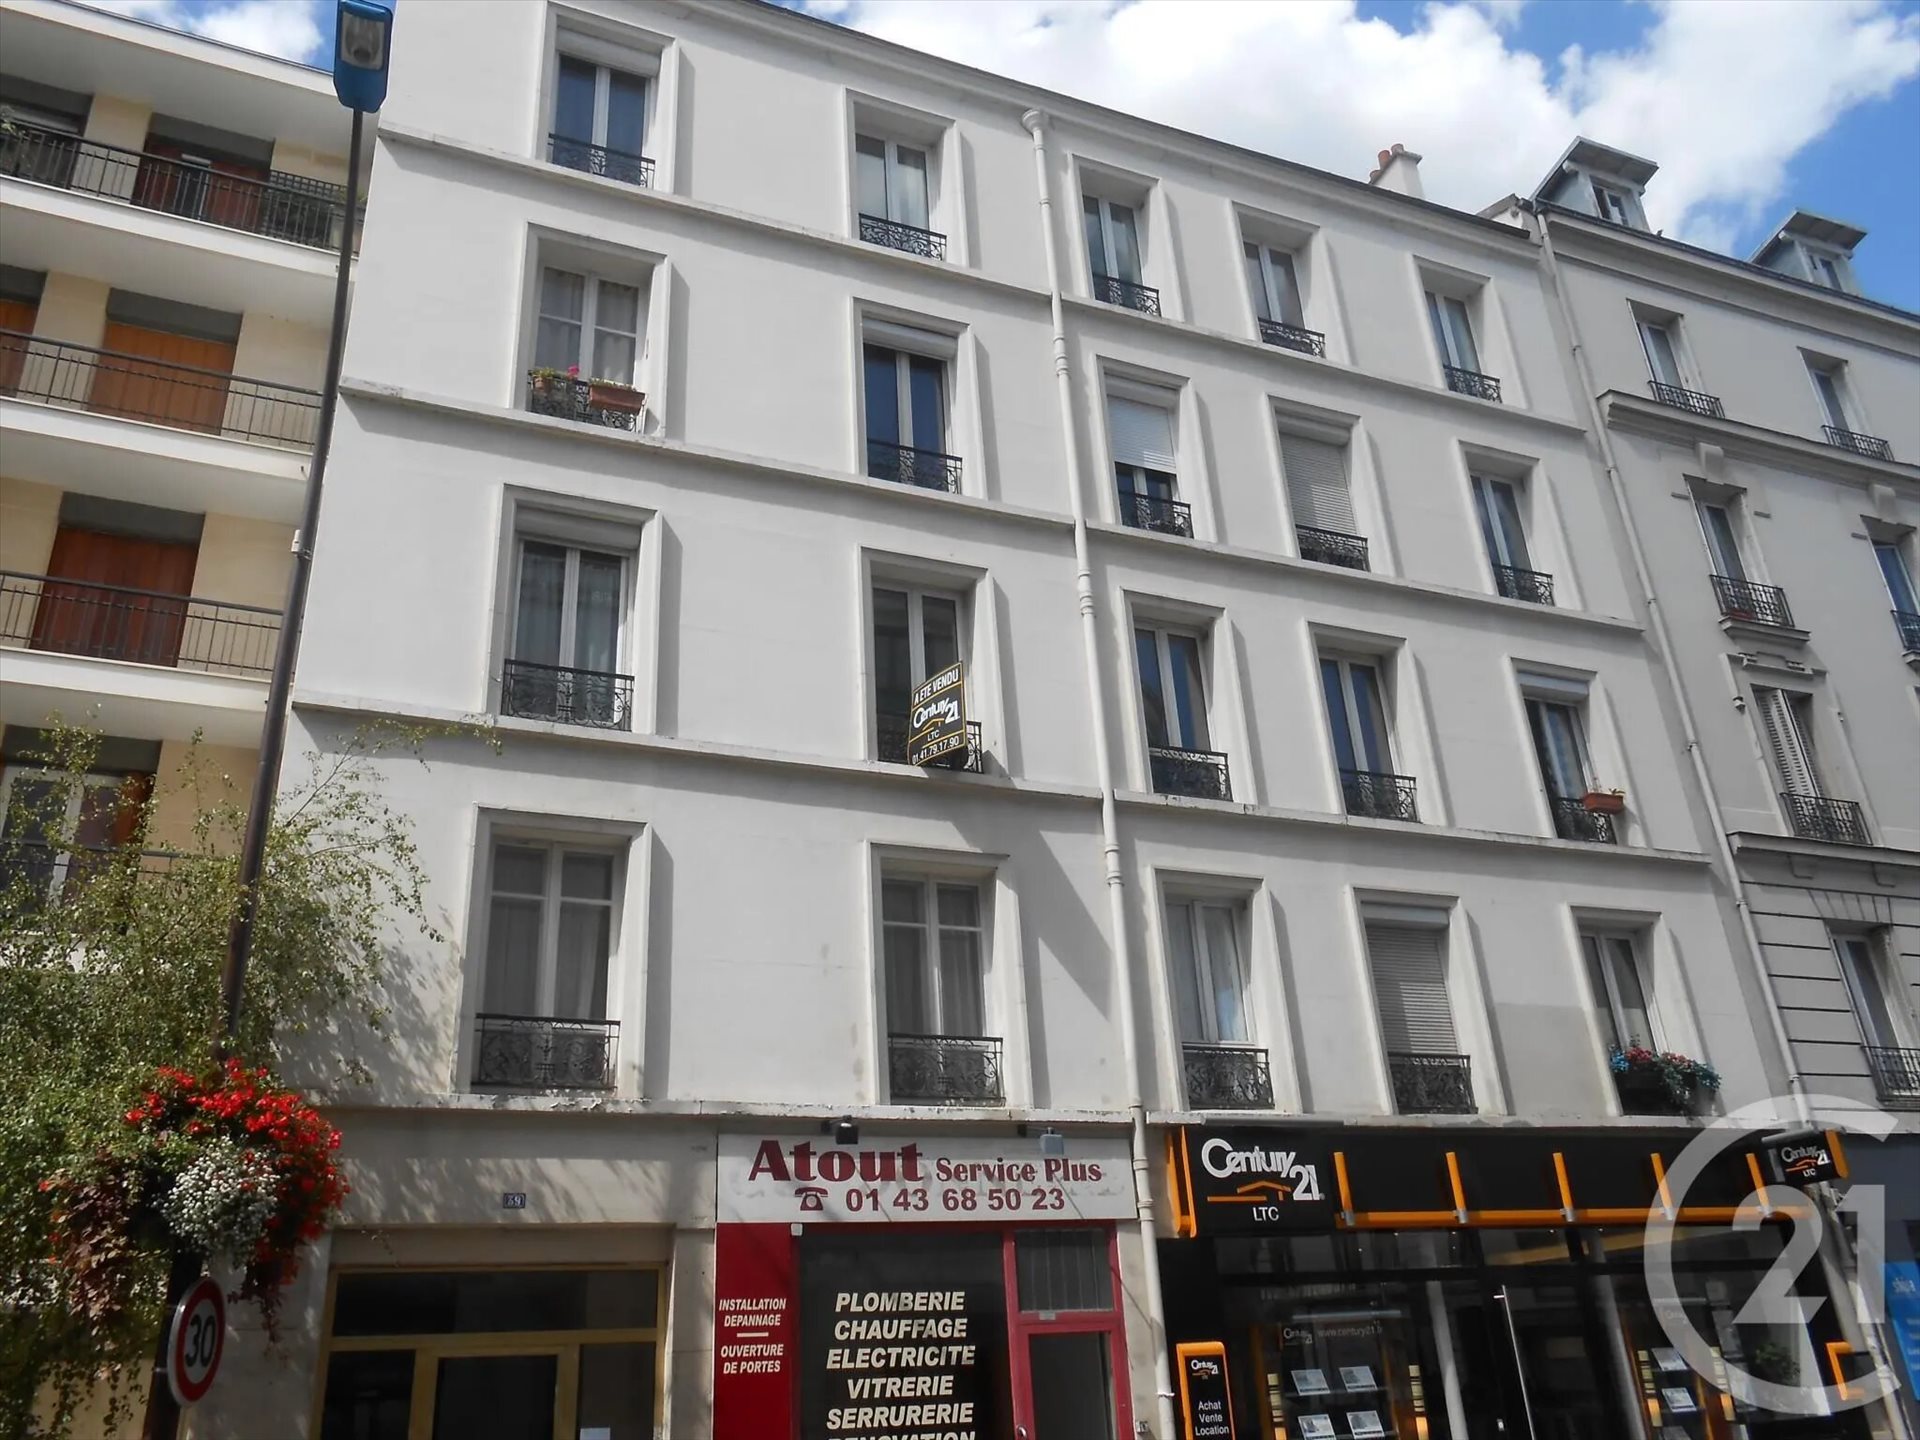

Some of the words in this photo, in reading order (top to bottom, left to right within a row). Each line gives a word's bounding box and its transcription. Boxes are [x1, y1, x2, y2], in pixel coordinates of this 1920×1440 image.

[914, 692, 919, 706] A
[919, 683, 932, 700] ETE
[933, 668, 959, 692] VENDU
[913, 697, 949, 729] Century
[945, 700, 960, 725] 21
[927, 729, 940, 742] LTC
[748, 1139, 925, 1182] Atout
[936, 1157, 1038, 1182] Service
[1044, 1158, 1103, 1182] Plus
[1781, 1145, 1818, 1163] Century
[1815, 1149, 1829, 1166] 21
[1201, 1137, 1296, 1178] Century
[1289, 1164, 1321, 1201] 21
[845, 1188, 879, 1212] 01
[893, 1188, 929, 1212] 43
[943, 1188, 977, 1211] 68
[988, 1188, 1021, 1211] 50
[1032, 1187, 1065, 1210] 23
[1252, 1206, 1279, 1221] LTC
[719, 1298, 787, 1311] INSTALLATION
[834, 1291, 966, 1313] PLOMBERIE
[724, 1314, 781, 1327] DEPANNAGE
[834, 1318, 968, 1341] CHAUFFAGE
[185, 1314, 216, 1368] 30
[720, 1344, 784, 1358] OUVERTURE
[723, 1361, 738, 1375] DE
[740, 1360, 781, 1374] PORTES
[826, 1345, 976, 1369] ELECTRICITE
[847, 1375, 954, 1400] VITRERIE
[826, 1402, 974, 1430] SERRURERIE
[1198, 1400, 1222, 1411] Achat
[1198, 1413, 1223, 1423] Vente
[1194, 1425, 1230, 1436] Location
